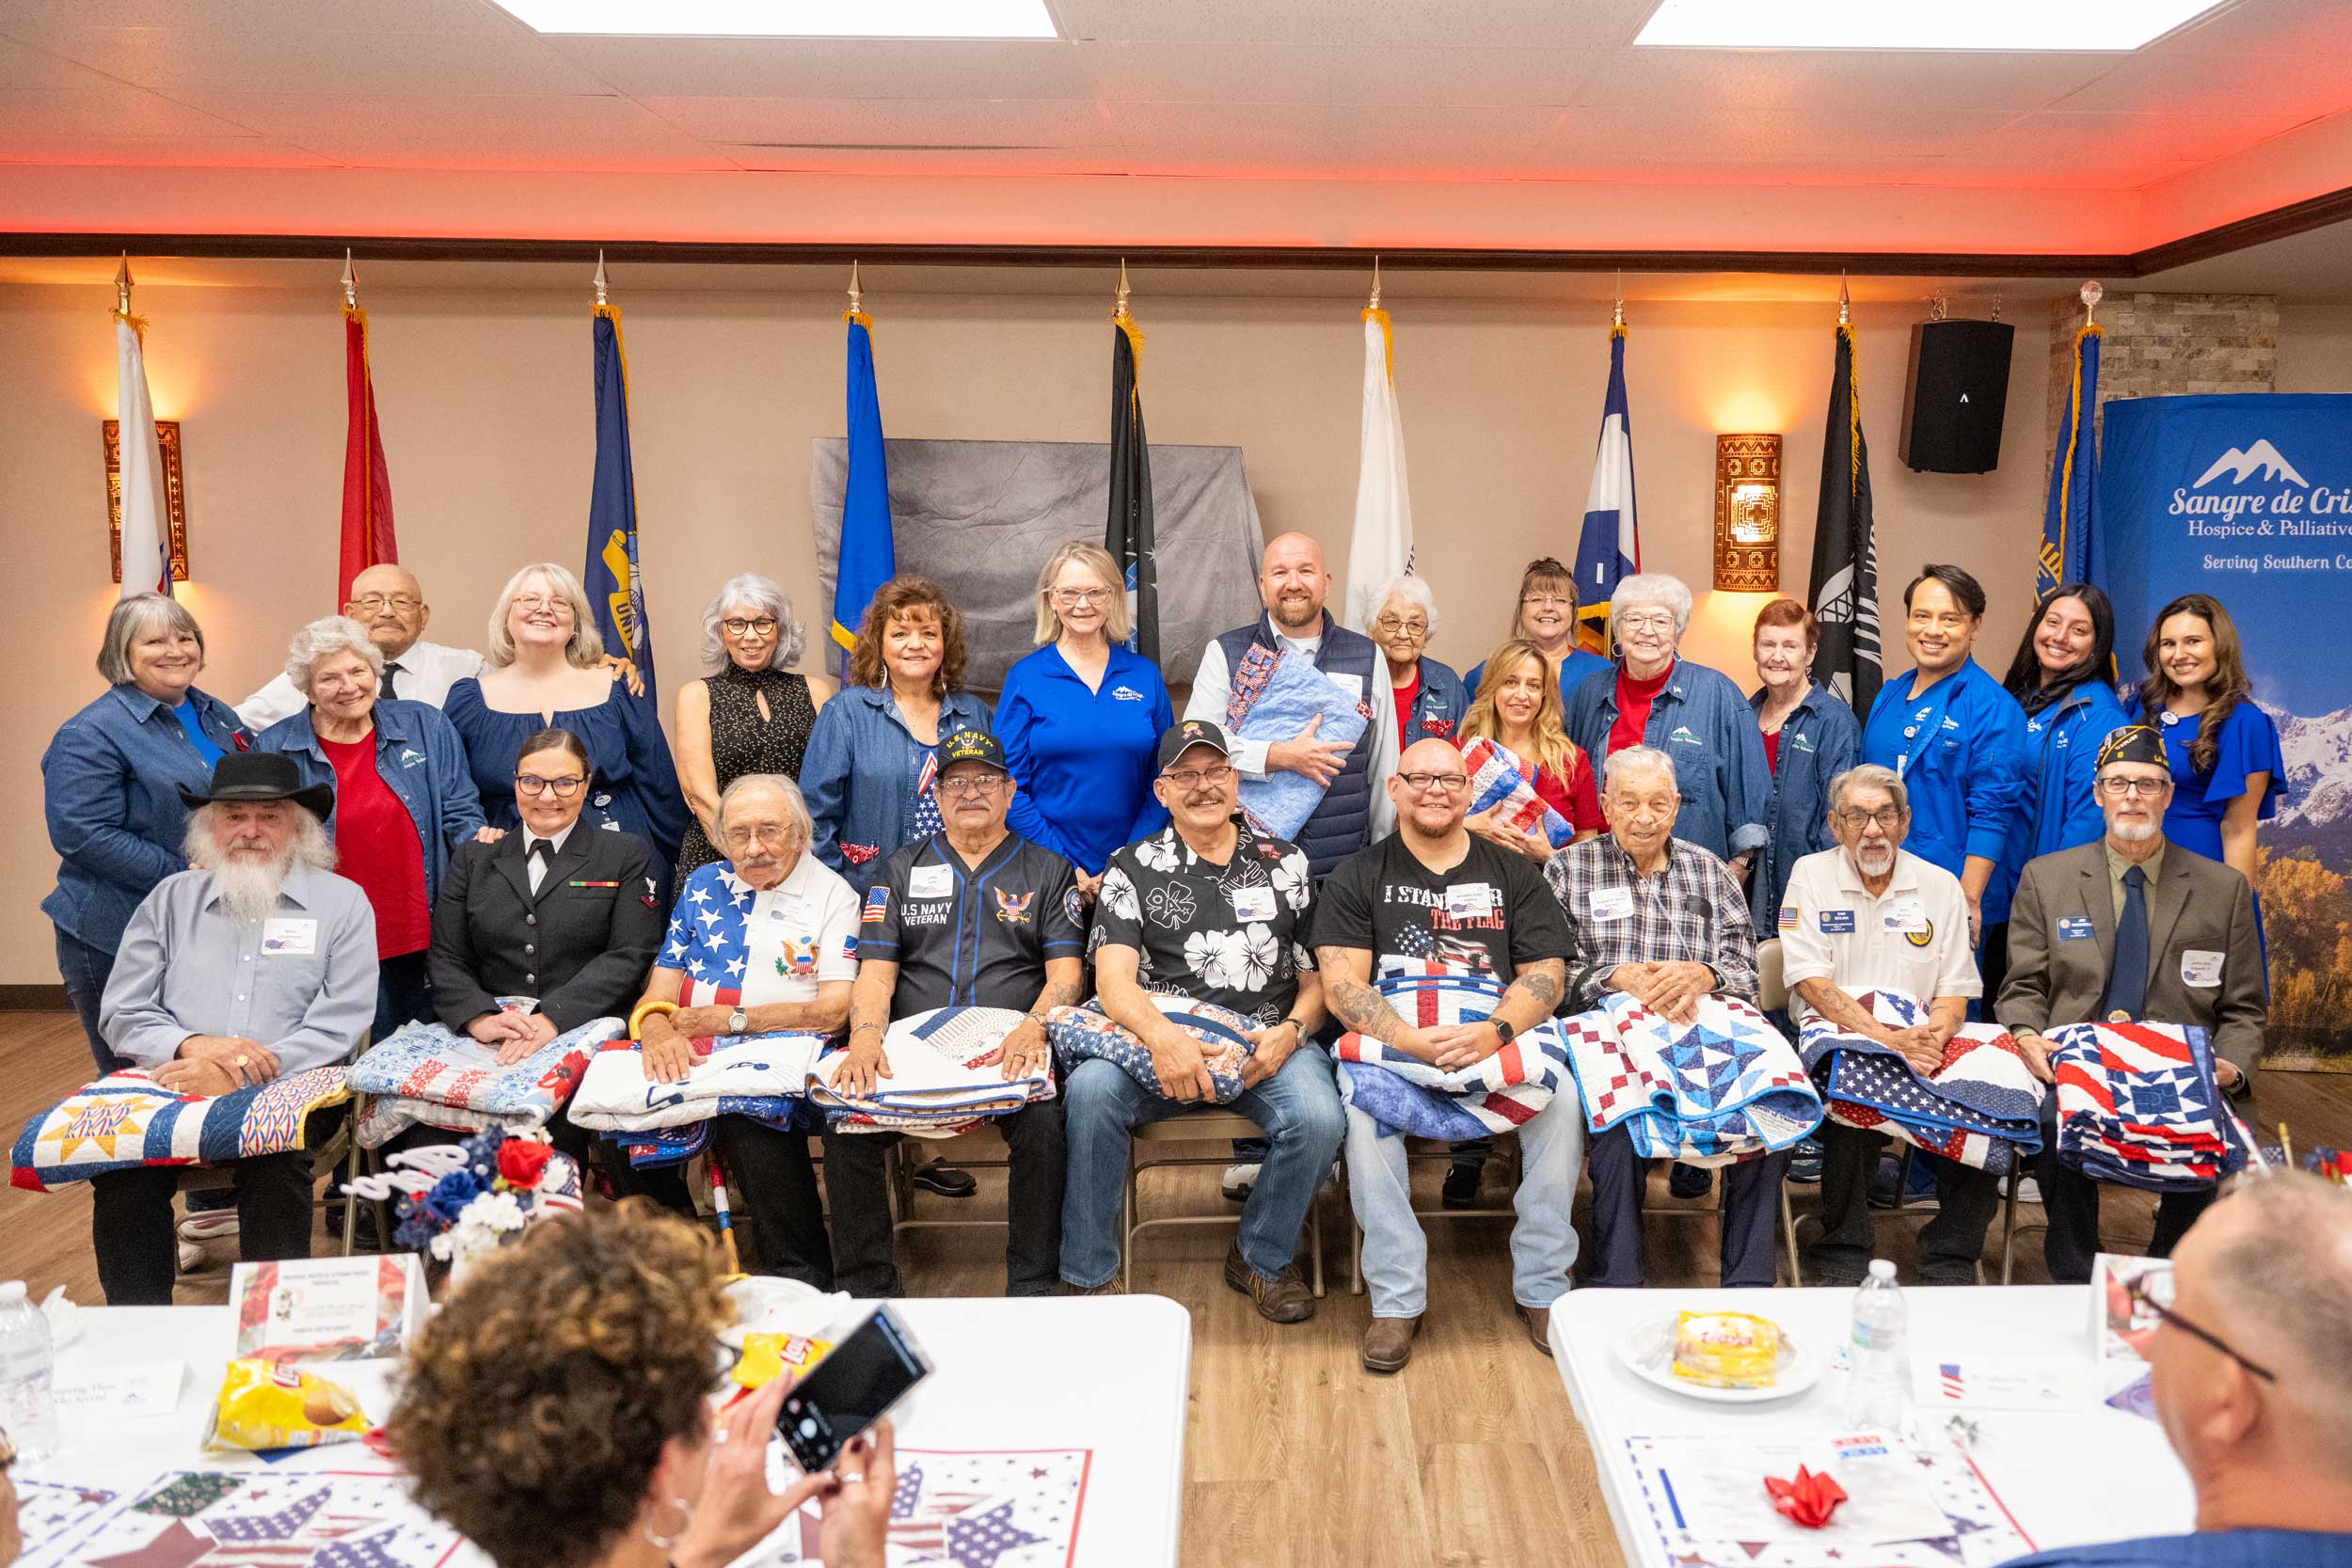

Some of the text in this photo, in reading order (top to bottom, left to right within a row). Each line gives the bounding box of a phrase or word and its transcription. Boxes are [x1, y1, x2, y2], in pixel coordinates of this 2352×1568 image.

[2169, 486, 2352, 522] Sangre de Cri
[2187, 520, 2352, 539] Hospice & Palliative
[2203, 555, 2258, 573] Serving
[2264, 555, 2329, 569] Southern
[951, 749, 984, 758] VETERAN
[1384, 884, 1392, 903] I
[920, 901, 953, 915] NAVY
[904, 913, 947, 927] VETERAN
